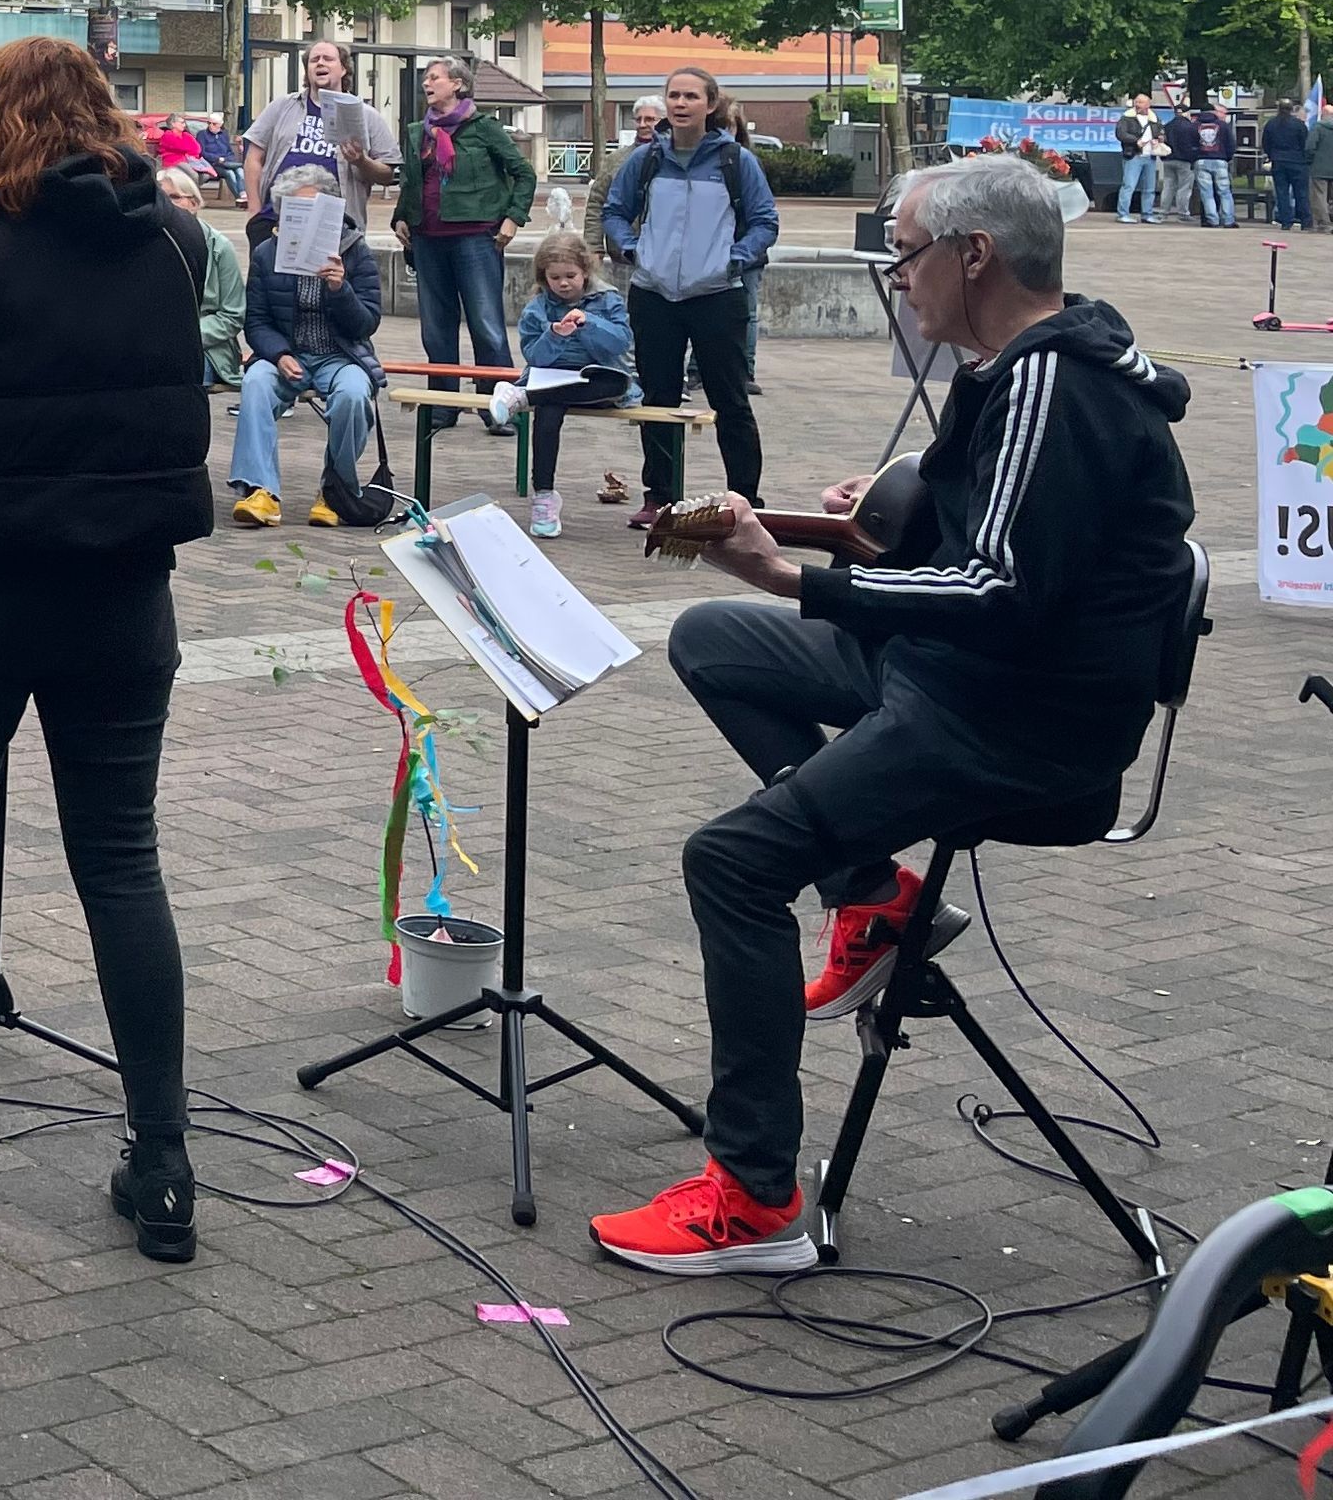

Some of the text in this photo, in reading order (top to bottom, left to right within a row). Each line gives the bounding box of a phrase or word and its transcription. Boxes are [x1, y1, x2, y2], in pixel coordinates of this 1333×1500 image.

[1026, 105, 1122, 123] Kein Pla
[1029, 124, 1116, 143] Faschis
